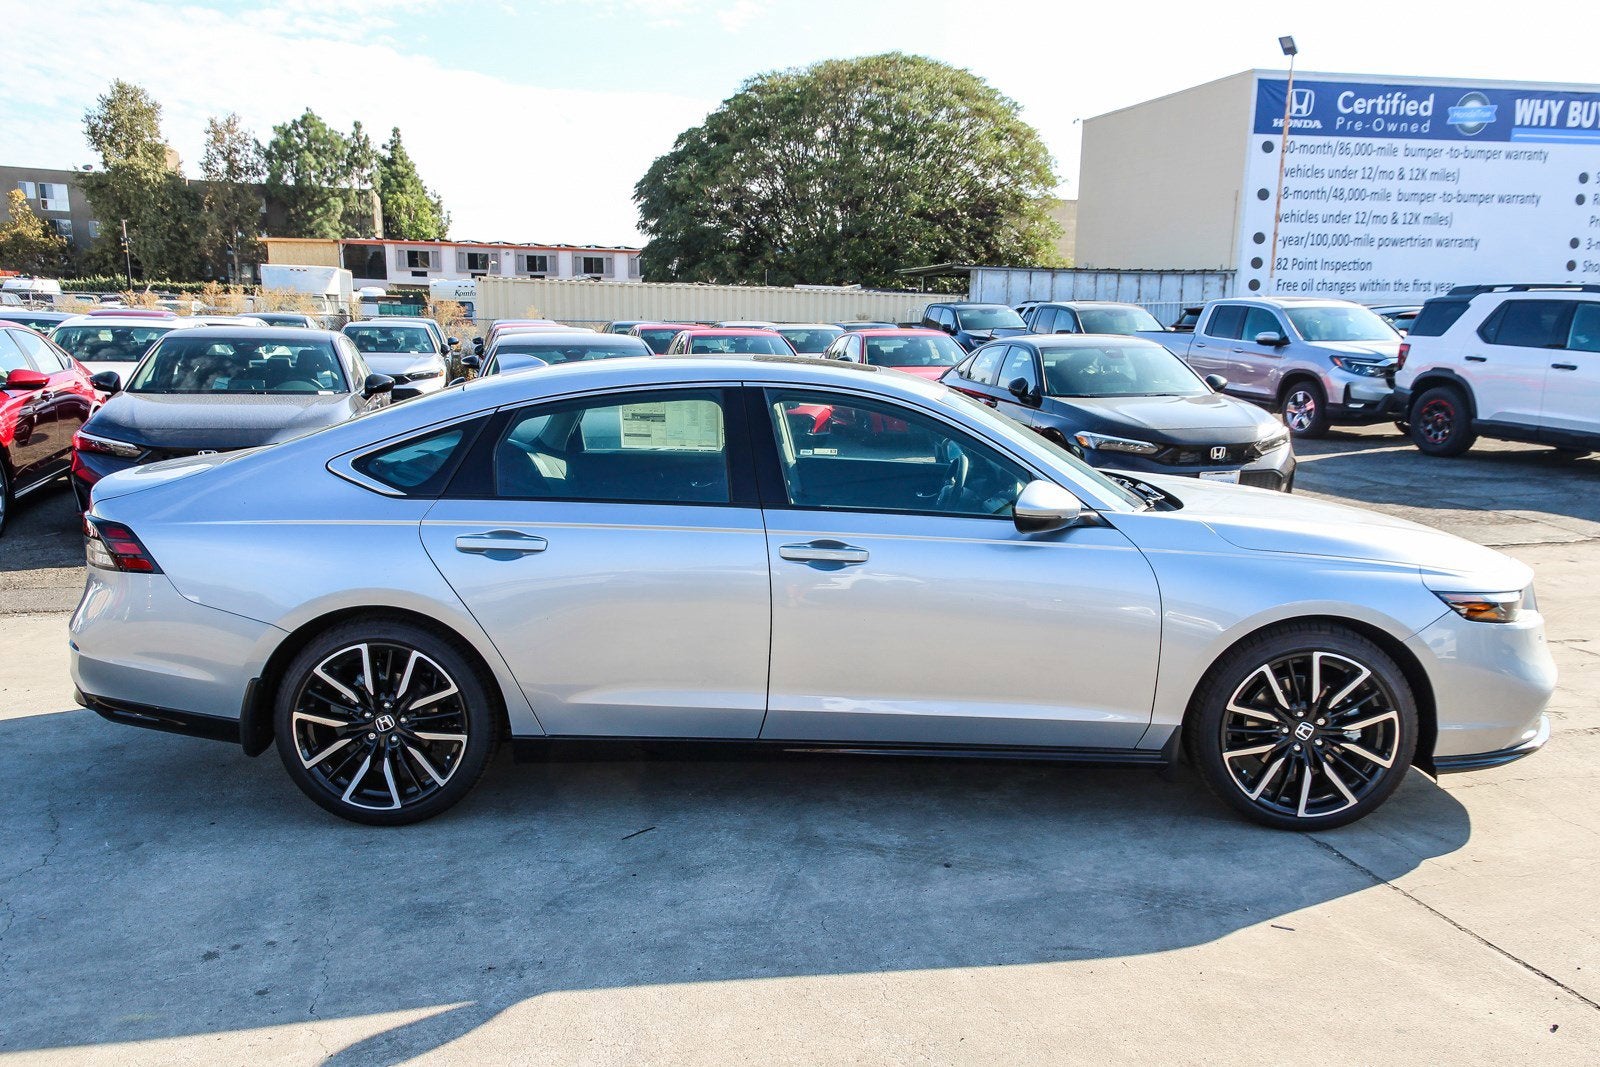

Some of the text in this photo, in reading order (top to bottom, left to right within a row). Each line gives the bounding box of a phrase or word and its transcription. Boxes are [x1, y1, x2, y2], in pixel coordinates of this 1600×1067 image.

[1337, 91, 1435, 117] Certified
[1515, 99, 1600, 128] WHY BU
[1272, 118, 1323, 129] HONDA
[1335, 117, 1431, 134] Pre-Owned
[1404, 143, 1443, 160] bumper
[1505, 149, 1550, 163] warranty
[1284, 164, 1460, 185] vehicles under 12/mo & 12K miles)
[1281, 185, 1392, 203] 8-month/48,000-mile
[1397, 188, 1436, 204] bumper
[1498, 192, 1541, 207] warranty
[1322, 210, 1352, 224] under
[1354, 210, 1388, 227] 12/mo
[1391, 211, 1399, 225] &
[1402, 211, 1420, 226] 12K
[1422, 212, 1453, 228] miles)
[1278, 231, 1480, 251] -year/100,000-mile powertrian warranty
[1273, 257, 1373, 274] 82 Point Inspection
[1276, 279, 1298, 292] Free
[1301, 279, 1313, 292] oil
[1316, 279, 1357, 294] changes
[1360, 279, 1390, 292] within
[1393, 279, 1409, 292] the
[1411, 279, 1432, 292] first
